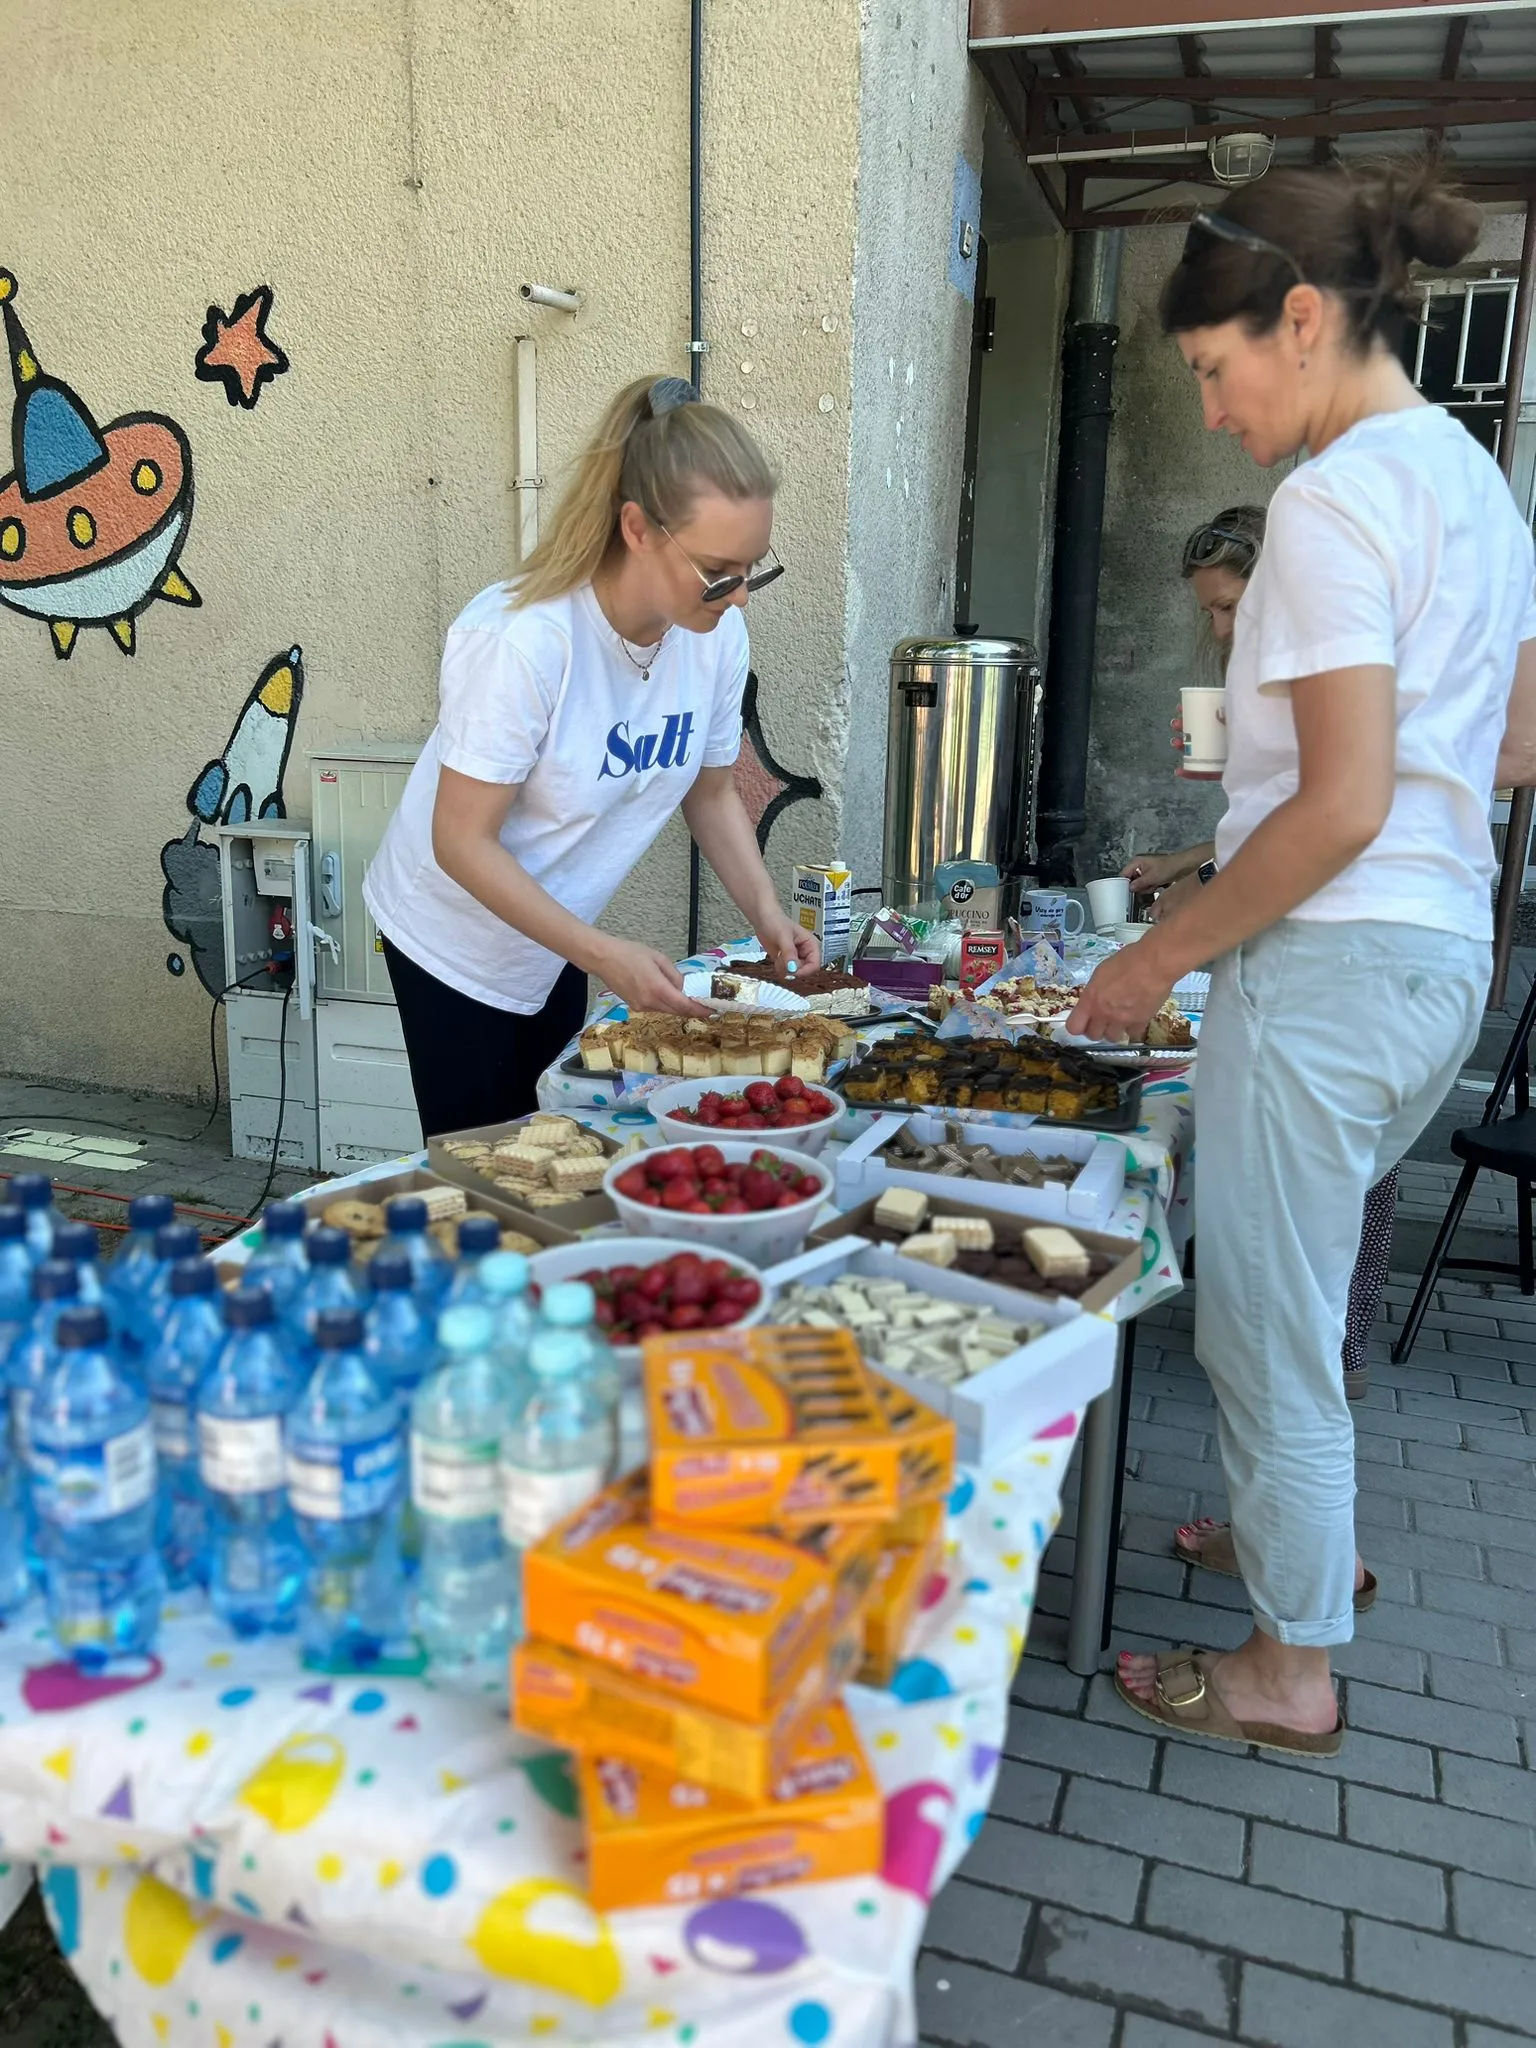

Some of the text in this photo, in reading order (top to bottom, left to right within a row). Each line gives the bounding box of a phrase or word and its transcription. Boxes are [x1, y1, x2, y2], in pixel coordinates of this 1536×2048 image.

[597, 711, 695, 781] Salt
[793, 892, 822, 908] UCHATE
[967, 945, 997, 953] REMSEY
